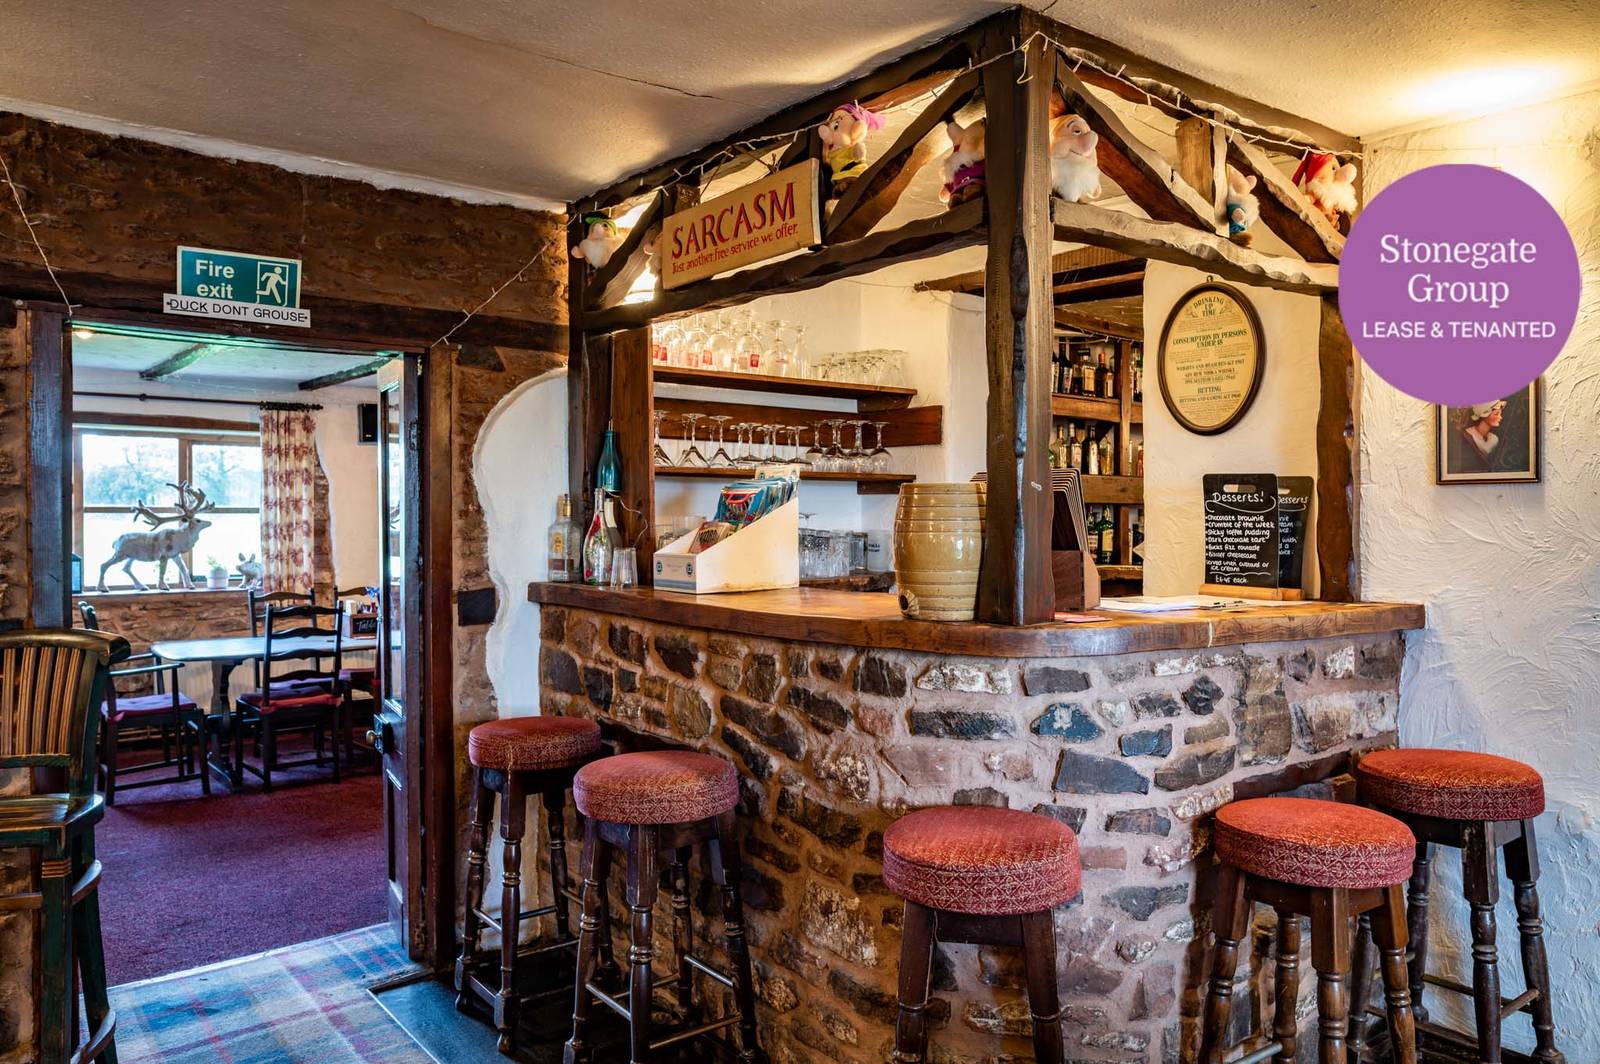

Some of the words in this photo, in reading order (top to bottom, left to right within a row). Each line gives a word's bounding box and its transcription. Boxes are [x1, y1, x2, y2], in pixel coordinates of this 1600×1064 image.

[672, 182, 796, 260] SARCASM
[672, 261, 685, 275] Just
[686, 252, 713, 271] another
[714, 247, 729, 261] free
[730, 237, 760, 256] service
[760, 233, 774, 244] we
[195, 259, 235, 279] Fire
[196, 282, 233, 299] exit
[1193, 296, 1225, 309] DRINKING
[169, 298, 208, 312] DUCK
[212, 304, 249, 316] DONT
[252, 308, 306, 323] GROUSE
[1201, 309, 1216, 317] TIME
[1172, 335, 1212, 346] CONSUMPTION
[1212, 332, 1220, 340] BY
[1221, 329, 1248, 339] PERSONS
[1196, 340, 1217, 348] UNDER
[1197, 385, 1222, 394] BETTING
[1212, 491, 1264, 503] Desserts!
[1237, 514, 1265, 522] brownie
[1255, 521, 1275, 529] week
[1244, 529, 1270, 539] pudding
